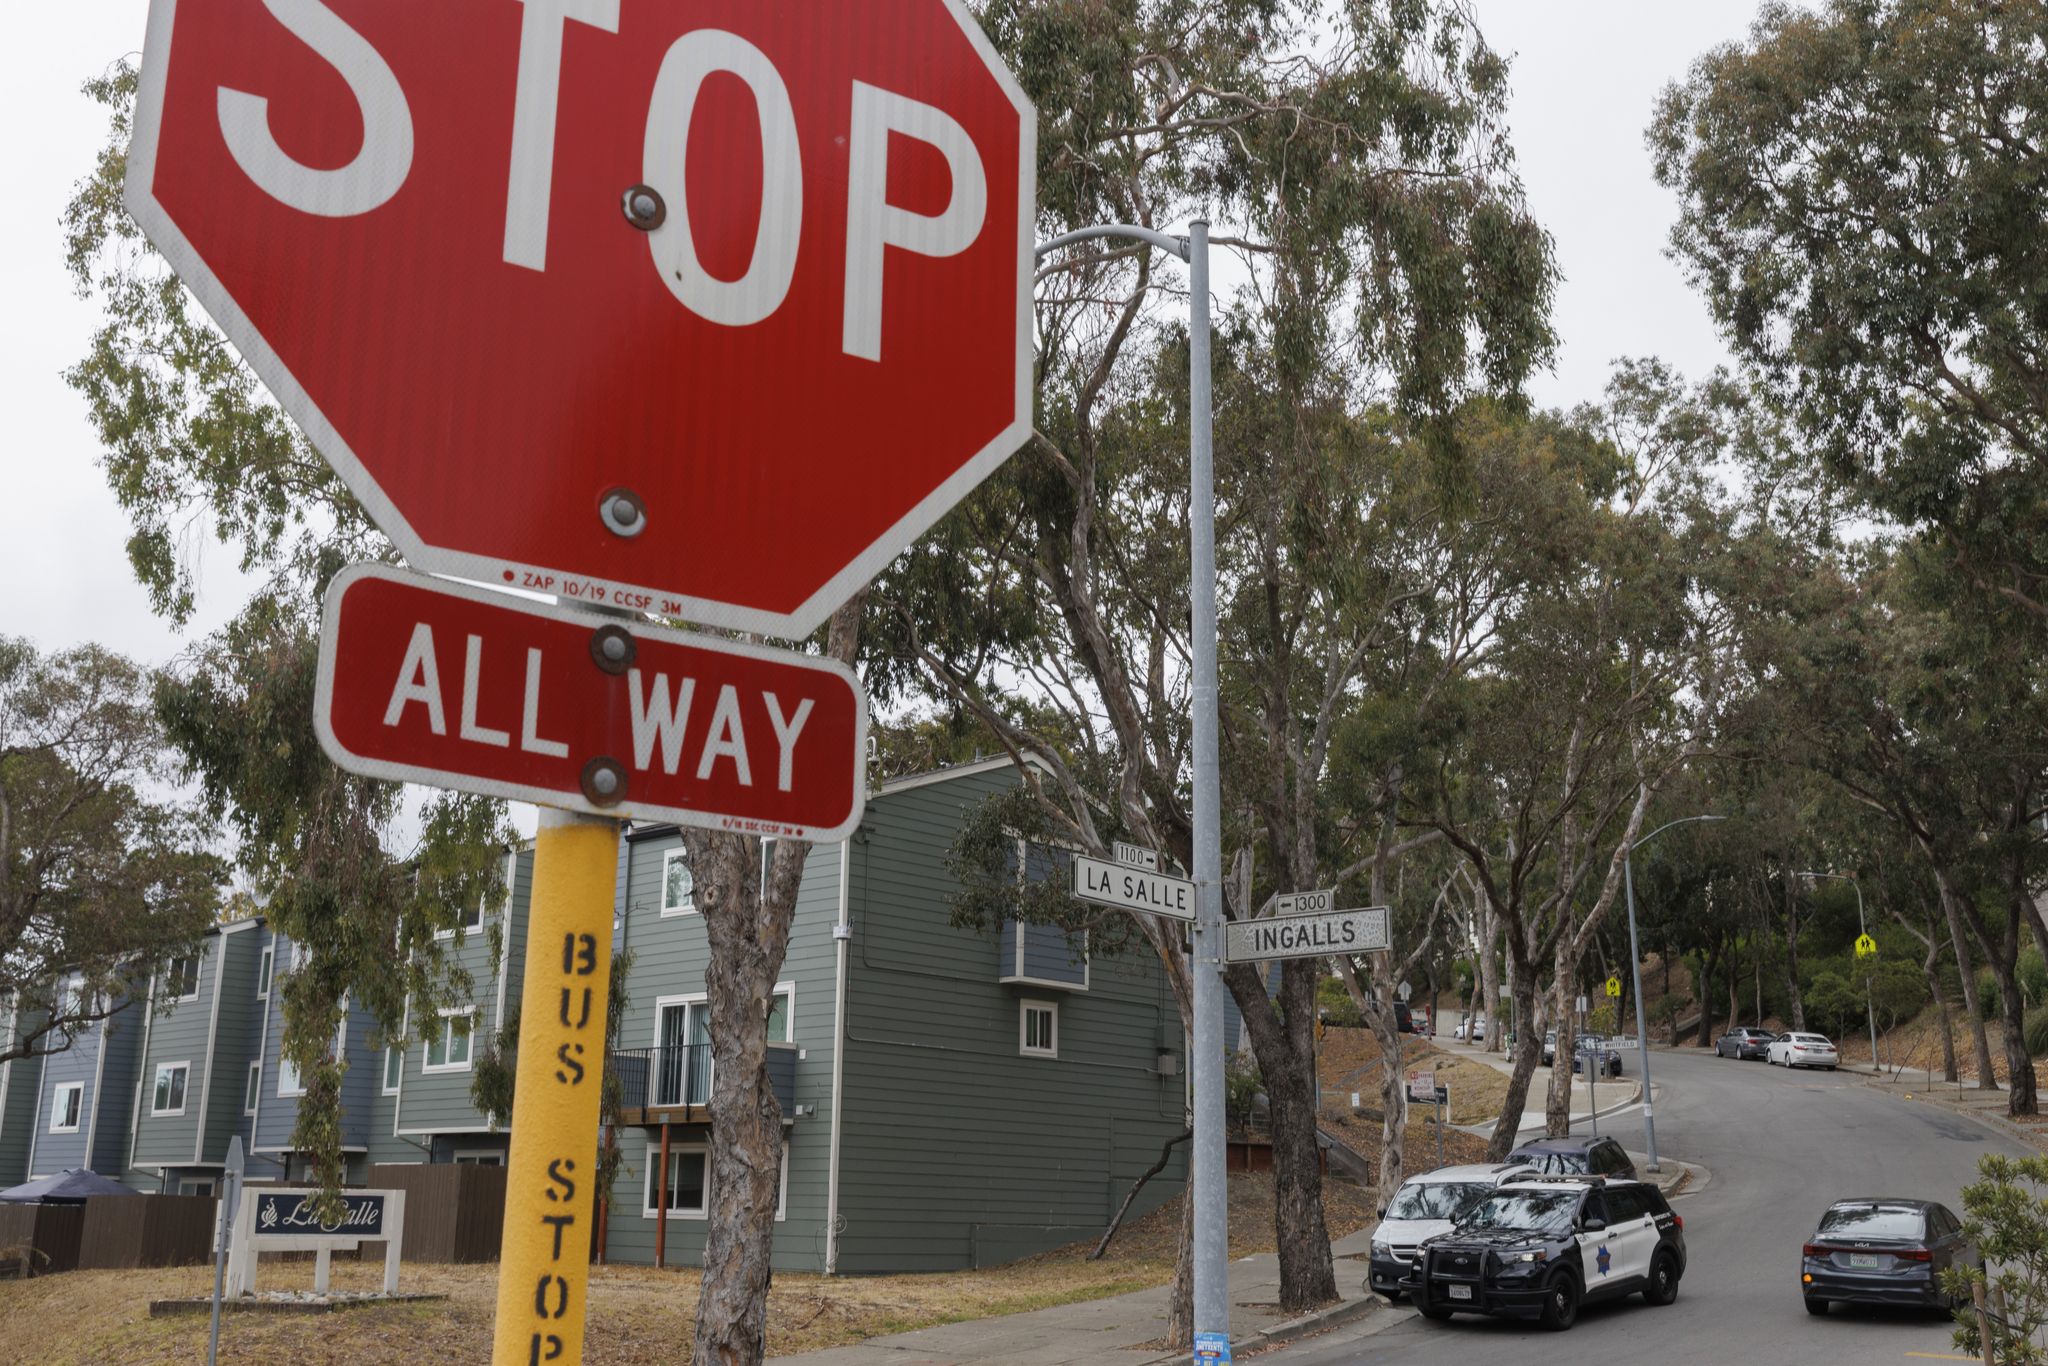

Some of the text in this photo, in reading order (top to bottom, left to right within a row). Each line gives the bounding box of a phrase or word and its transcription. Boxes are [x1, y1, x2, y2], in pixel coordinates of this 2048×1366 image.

[216, 0, 988, 362] STOP
[523, 572, 682, 615] ZAP 10/19 CCSF 3M
[383, 622, 815, 792] ALL WAY
[1119, 845, 1144, 865] 1100
[1087, 867, 1187, 911] LA SALLE
[1294, 896, 1327, 911] 1300
[1255, 920, 1356, 951] INGALLS
[554, 932, 597, 1086] BUS
[528, 1158, 576, 1366] STOP
